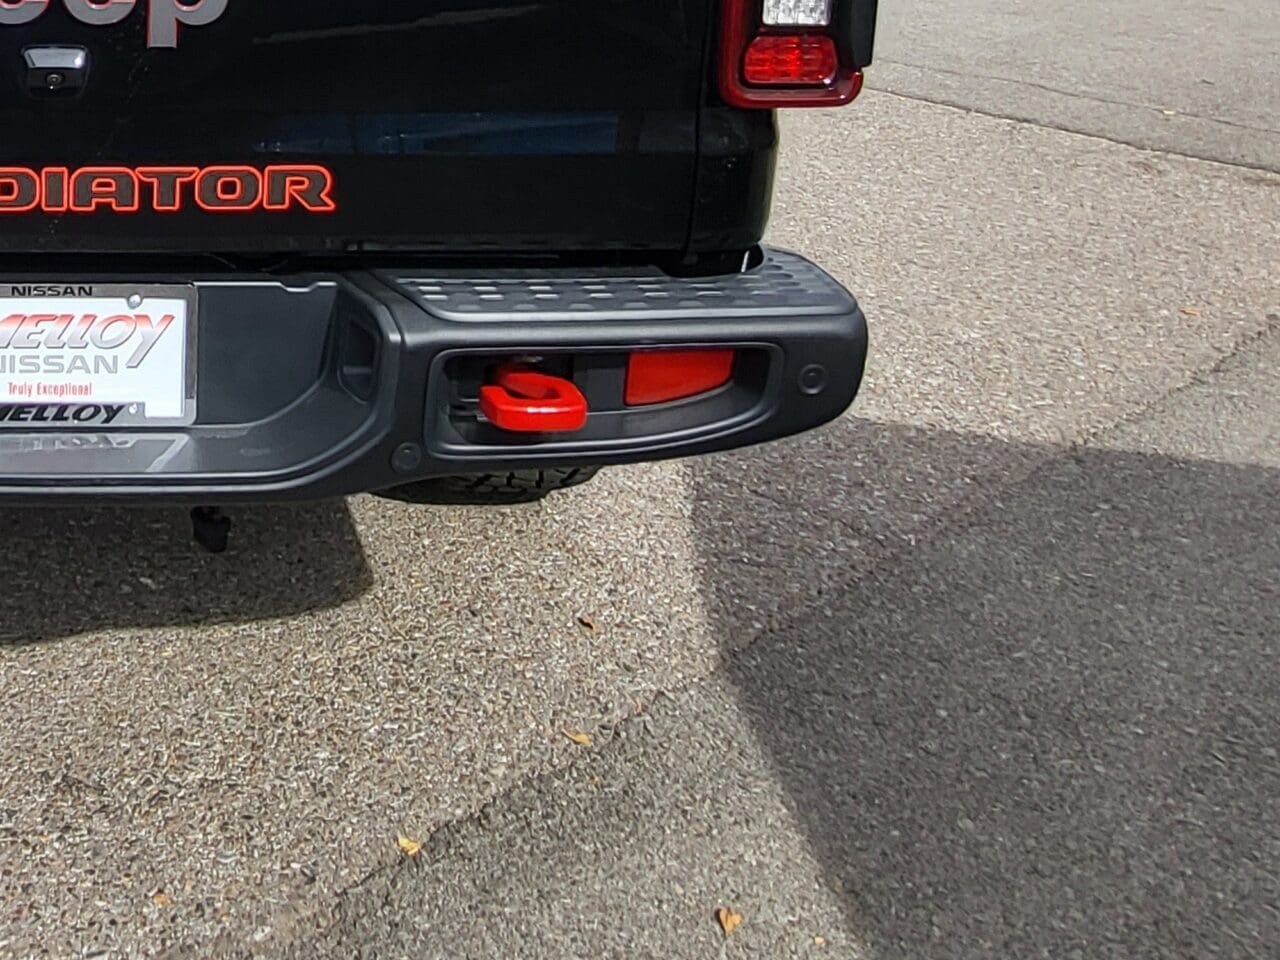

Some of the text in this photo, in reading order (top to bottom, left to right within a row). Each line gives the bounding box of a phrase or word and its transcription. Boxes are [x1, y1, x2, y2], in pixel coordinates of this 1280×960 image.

[10, 285, 93, 297] NISSAN
[7, 381, 93, 398] Truly Exceptional
